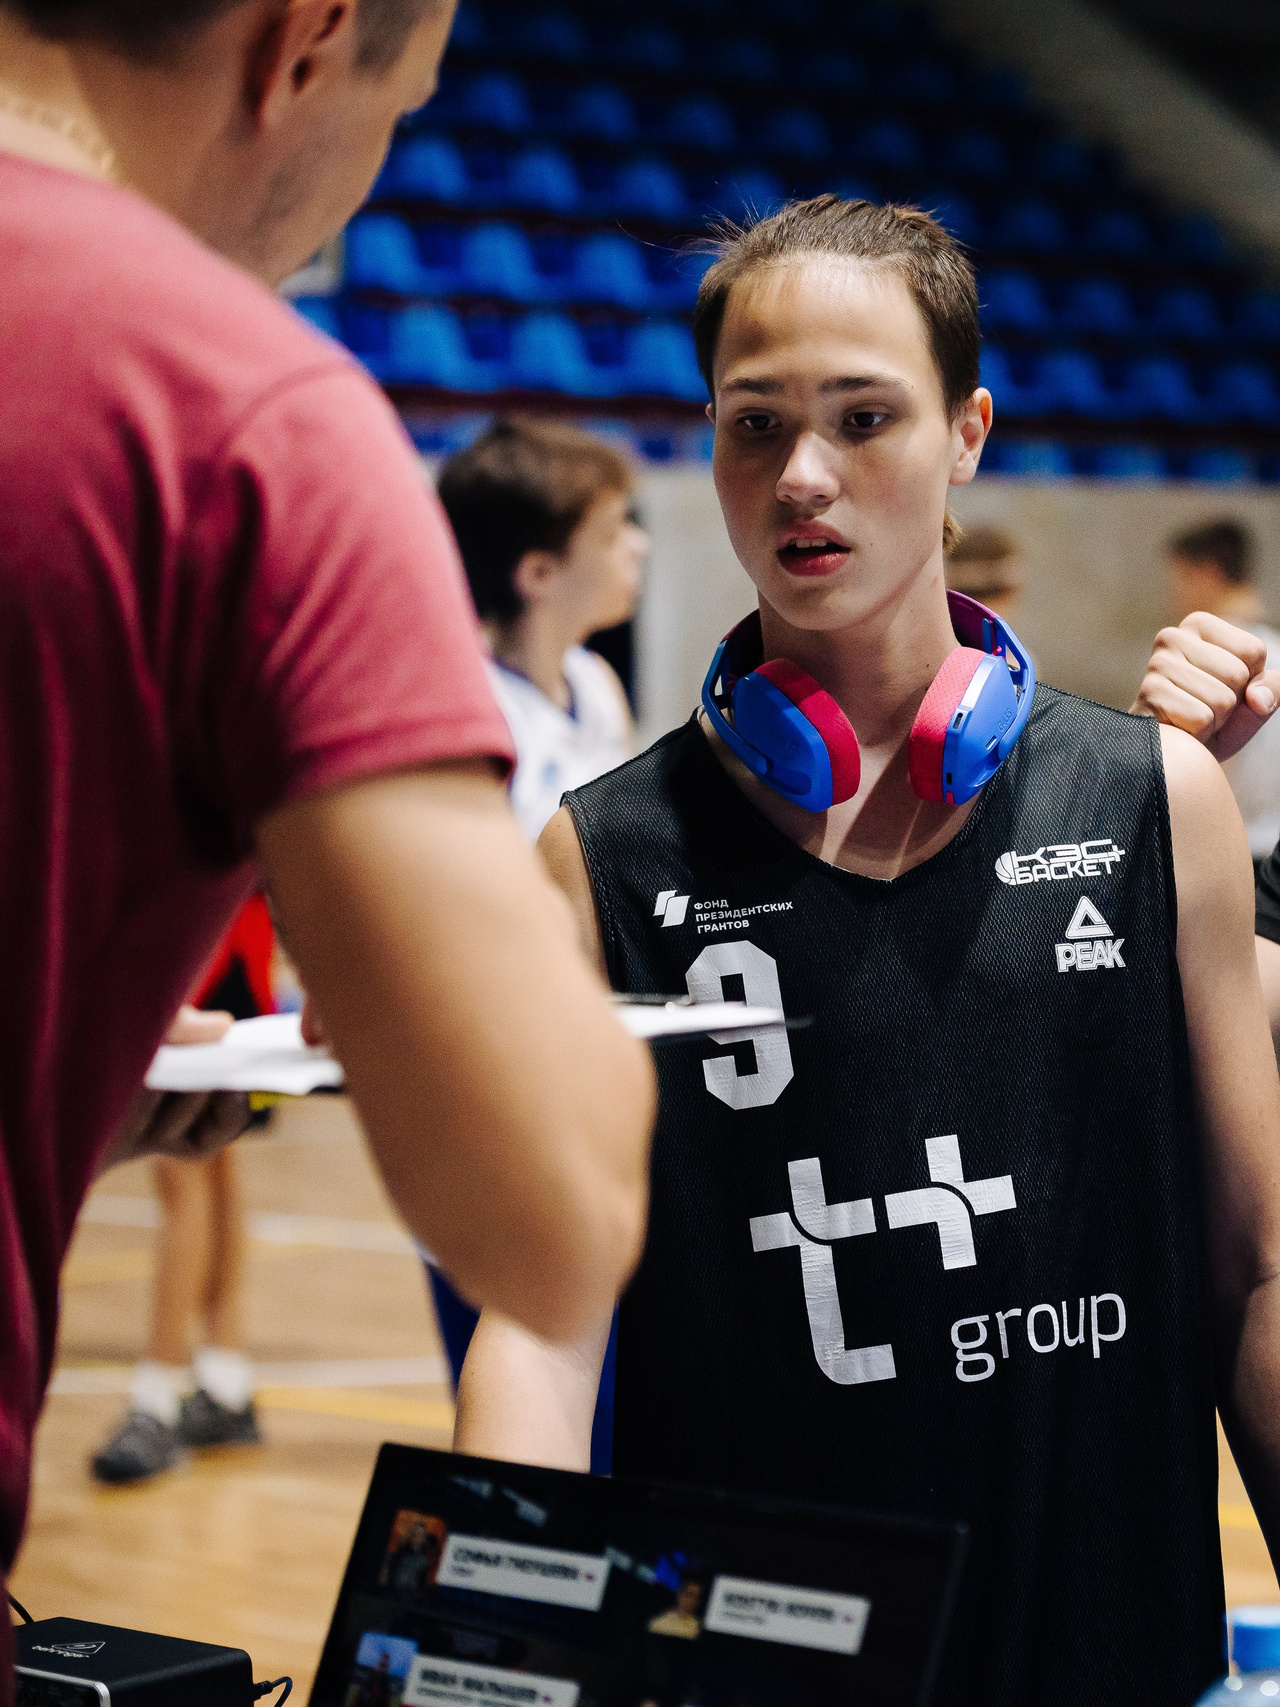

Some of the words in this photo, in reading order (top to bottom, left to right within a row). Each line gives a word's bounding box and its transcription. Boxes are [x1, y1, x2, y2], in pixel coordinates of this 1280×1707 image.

[1015, 858, 1117, 885] БАСКЕТ
[693, 899, 729, 910] ФОНД
[695, 901, 794, 922] ПРЕЗИДЕНТСКИХ
[697, 919, 750, 934] ГРАНТОВ
[1055, 938, 1127, 973] PEAK
[685, 940, 794, 1110] 9
[950, 1293, 1127, 1383] group
